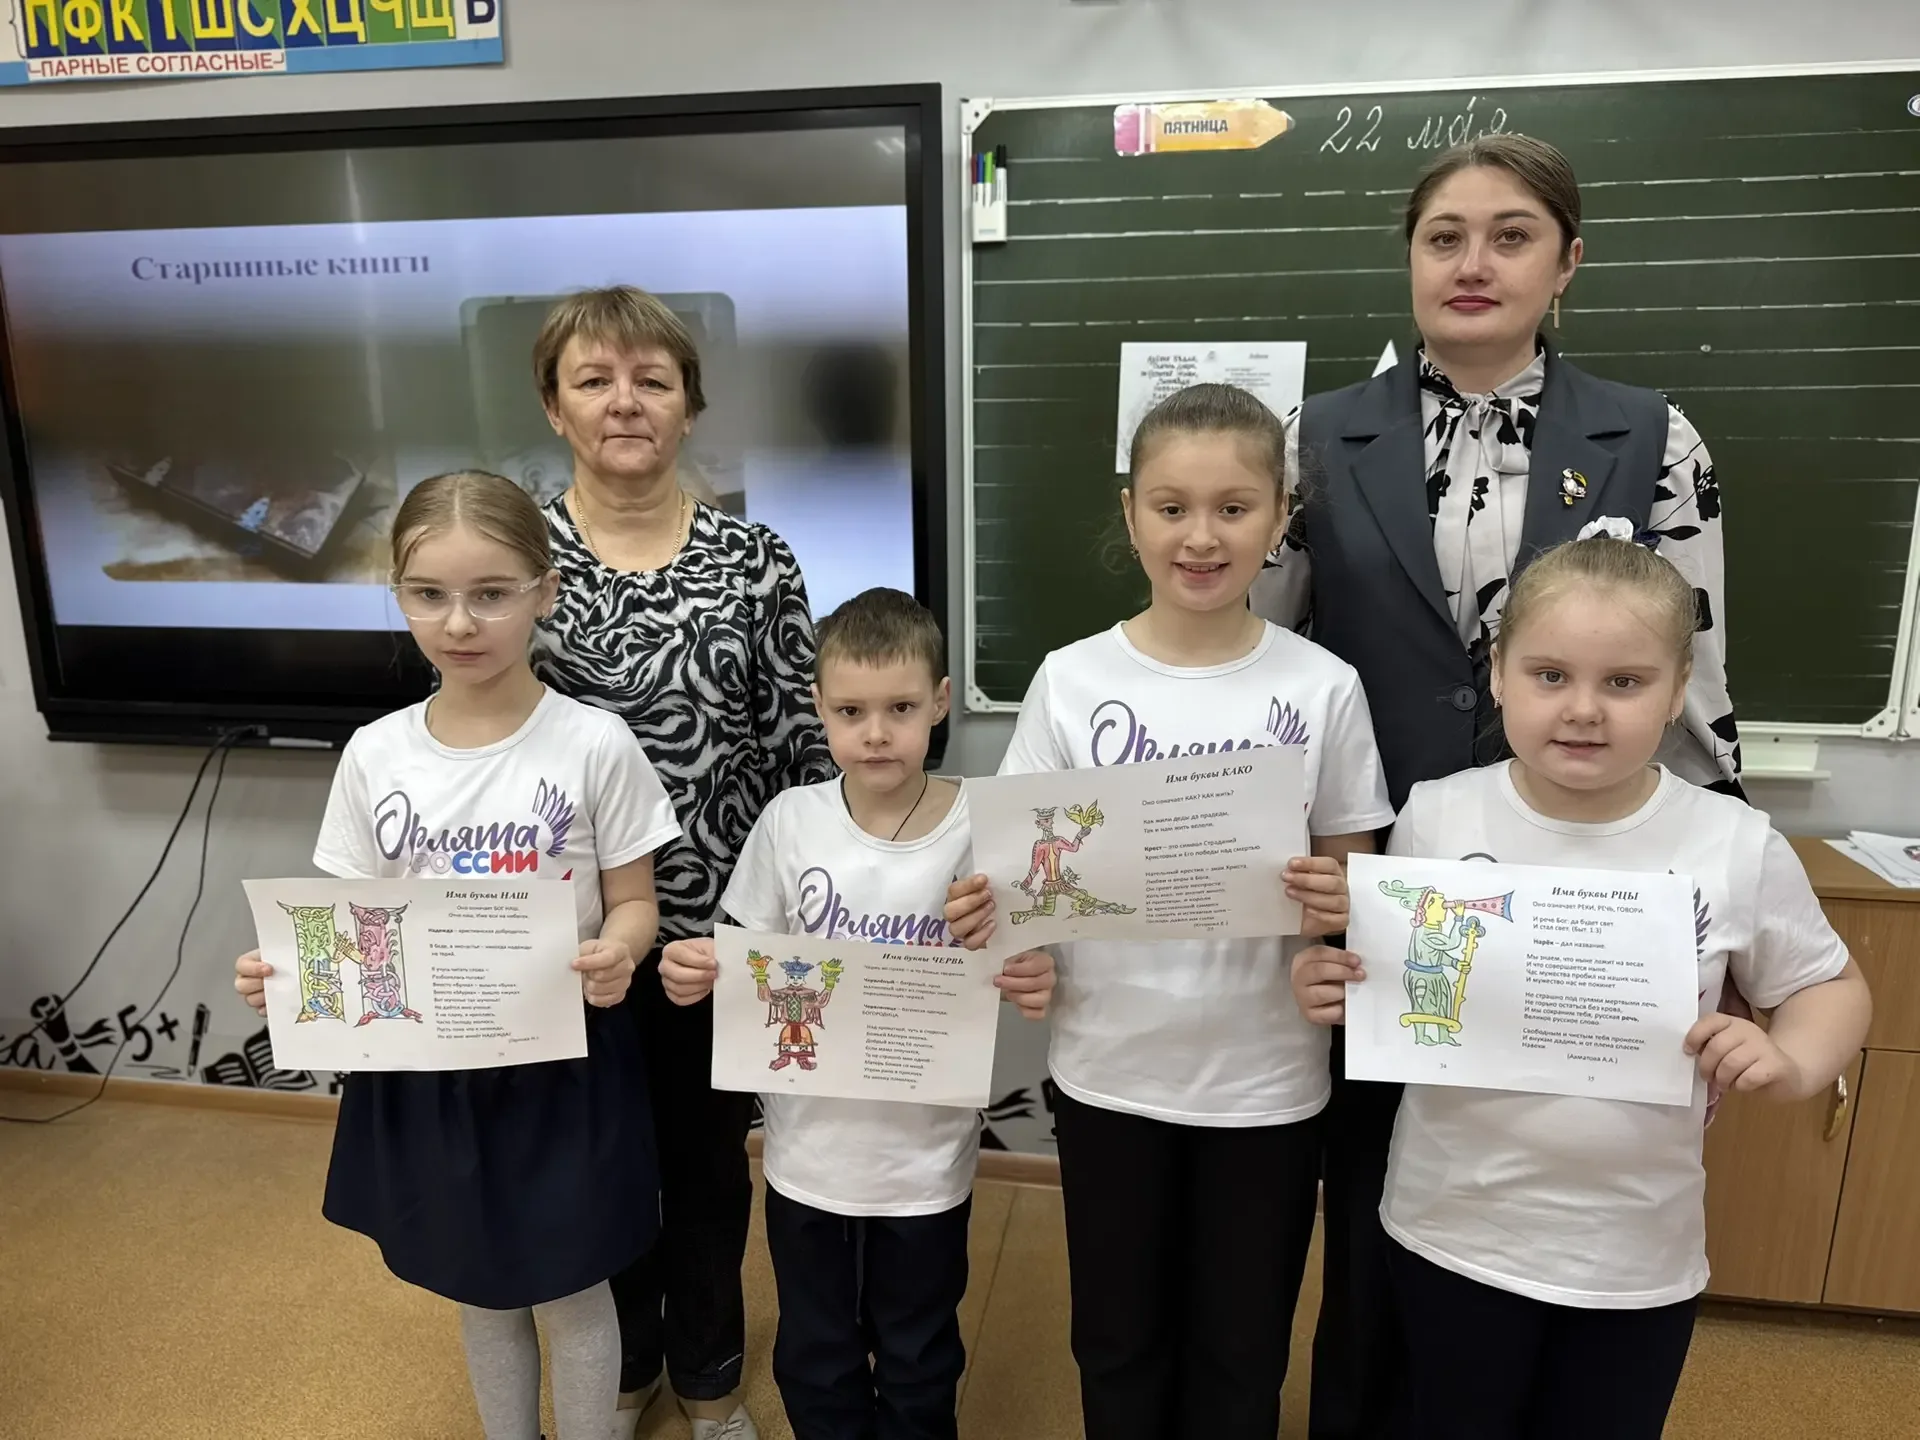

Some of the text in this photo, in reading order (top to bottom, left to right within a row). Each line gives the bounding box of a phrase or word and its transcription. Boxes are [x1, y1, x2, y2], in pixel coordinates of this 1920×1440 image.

[41, 52, 274, 77] ПАРНЫЕ СОГЛАСНЫЕ
[1164, 119, 1229, 135] ПЯТНИЦА
[1320, 106, 1383, 154] 22
[131, 255, 430, 285] Старинные книги
[1165, 765, 1252, 784] Имя буквы КАКО
[374, 790, 540, 867] Орлята
[411, 849, 539, 875] РОССИИ
[445, 891, 528, 900] Имя буквы НАШ
[1552, 887, 1639, 900] Имя буквы РЦЫ
